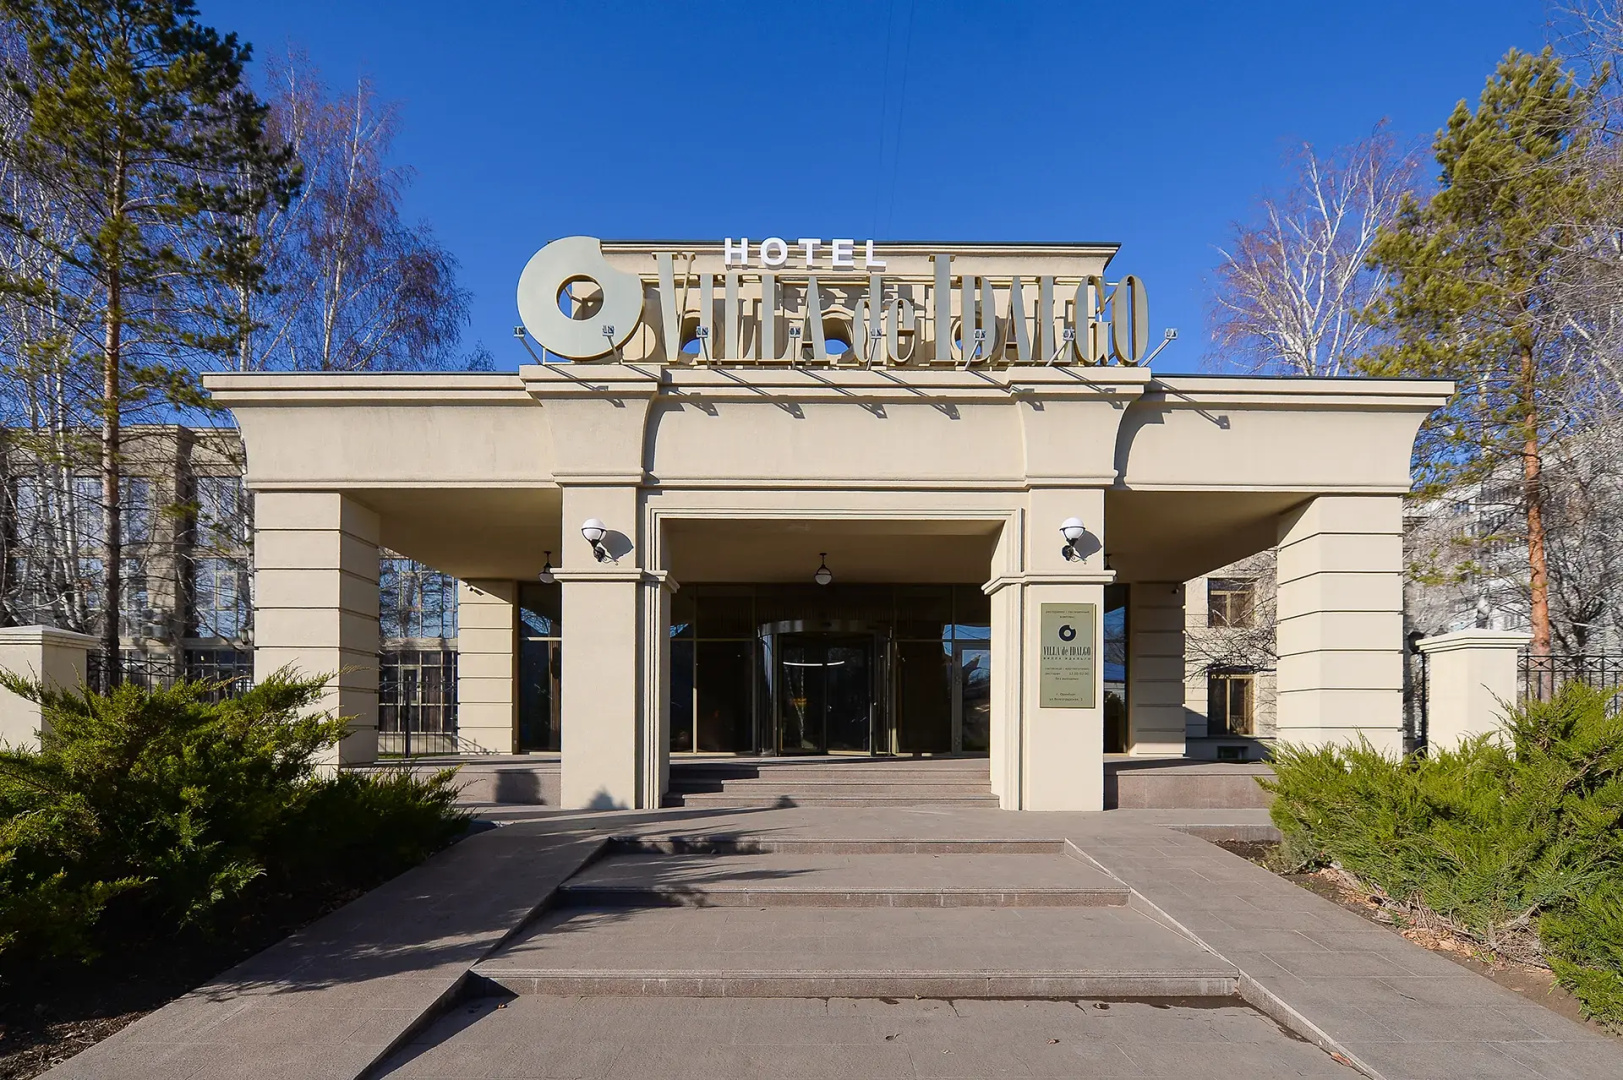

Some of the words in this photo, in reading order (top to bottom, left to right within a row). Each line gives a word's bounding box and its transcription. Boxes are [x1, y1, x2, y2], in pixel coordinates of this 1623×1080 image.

[724, 237, 887, 271] HOTEL
[651, 251, 831, 362] VILLA
[853, 274, 915, 364] de
[928, 253, 1150, 367] IDALGO
[1043, 646, 1061, 656] VILLA
[1069, 646, 1092, 656] IDALGO
